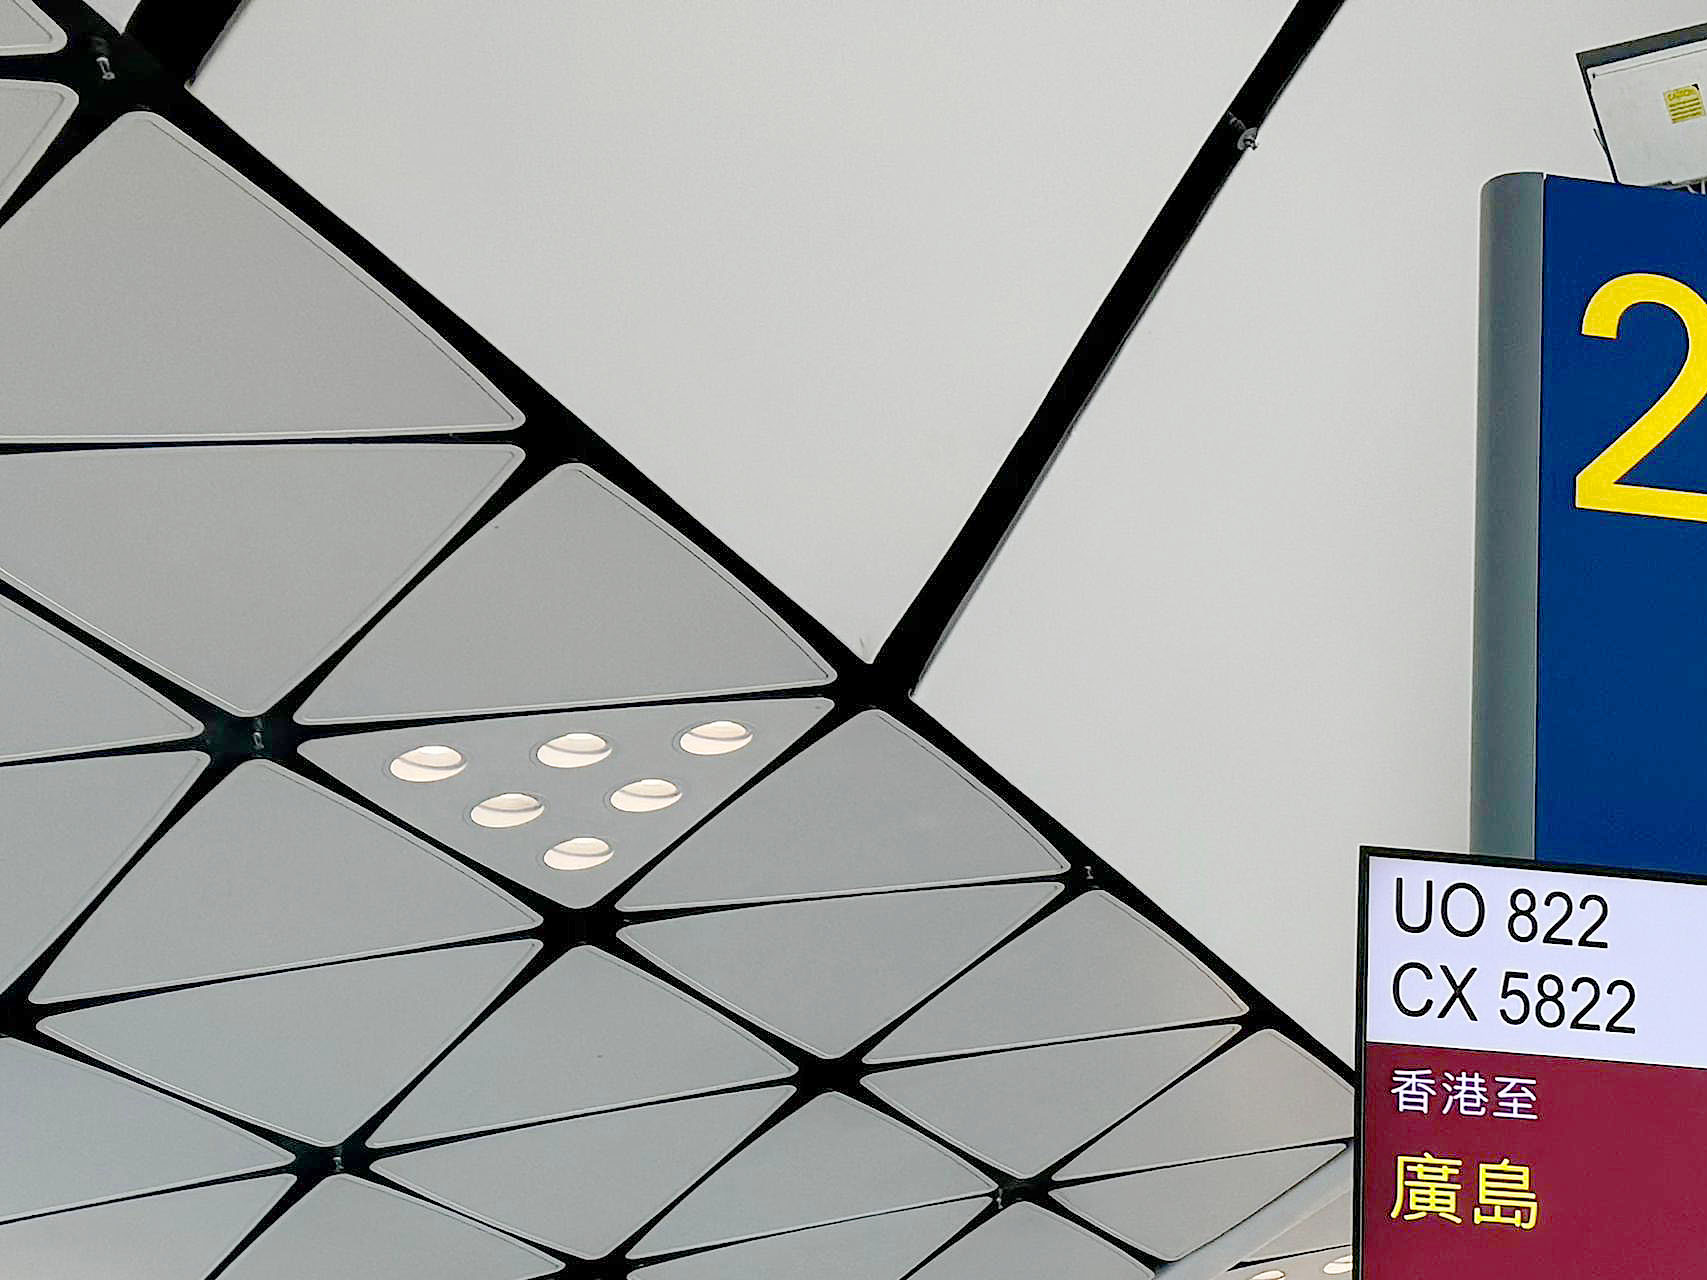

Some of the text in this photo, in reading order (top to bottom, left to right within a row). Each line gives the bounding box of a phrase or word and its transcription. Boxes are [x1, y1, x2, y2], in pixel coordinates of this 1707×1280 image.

[1393, 876, 1610, 950] UO 822
[1390, 960, 1637, 1036] CX 5822
[1388, 1066, 1540, 1122] 香港至
[1388, 1152, 1540, 1231] 廣島
